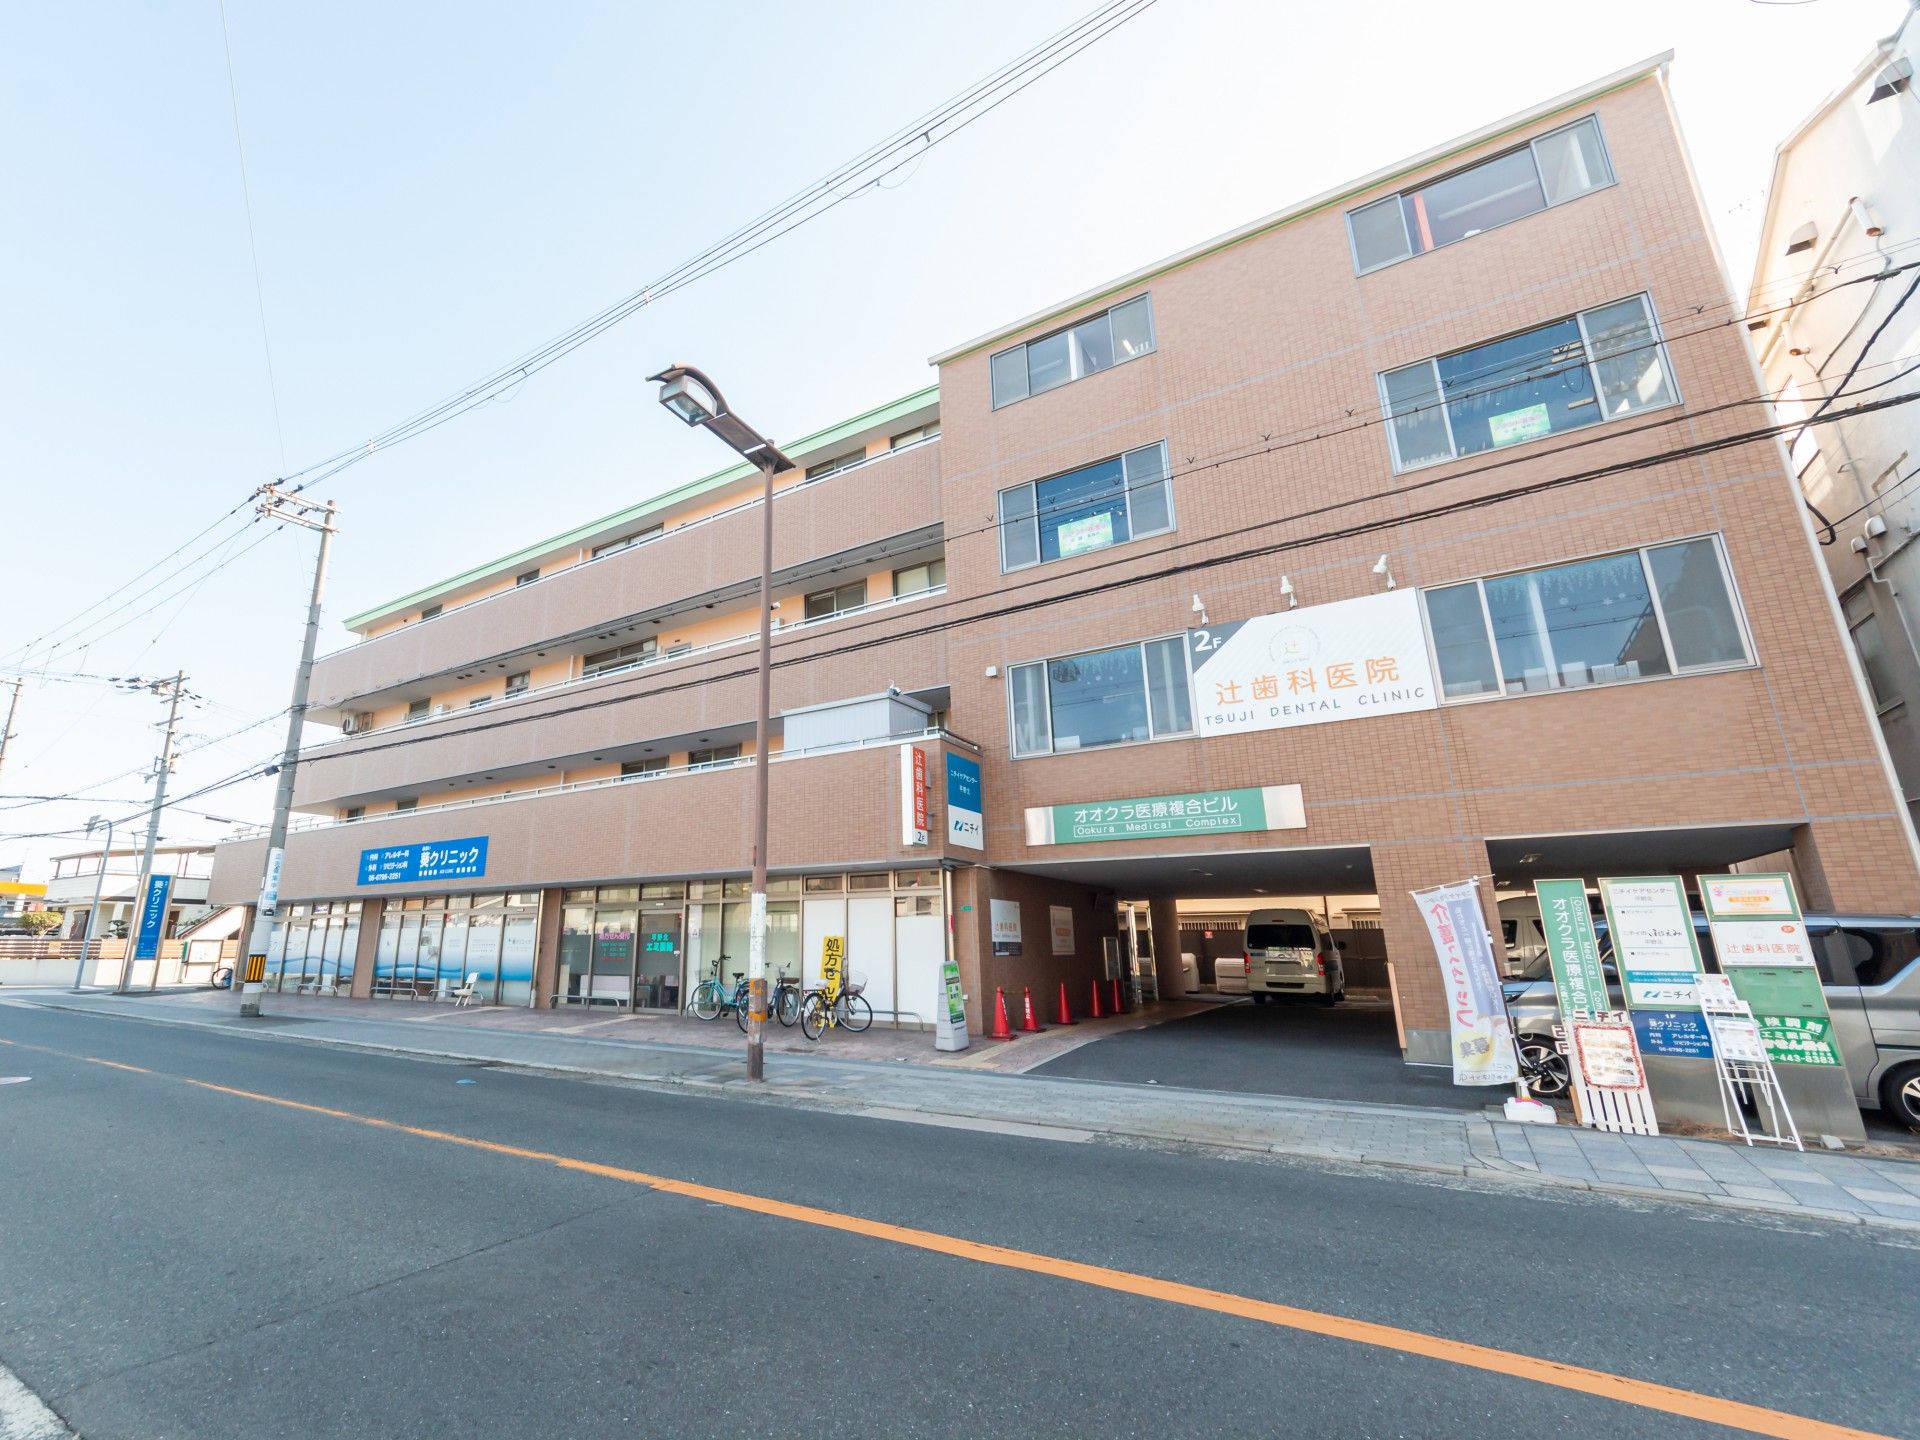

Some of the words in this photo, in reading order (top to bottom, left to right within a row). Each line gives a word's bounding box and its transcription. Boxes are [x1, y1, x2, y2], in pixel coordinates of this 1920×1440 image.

[1194, 630, 1222, 652] 2F
[1215, 655, 1400, 706] 辻歯科医院
[1204, 710, 1255, 726] TSUJI
[1270, 698, 1341, 717] DENTAL
[1358, 687, 1425, 706] CLINIC
[1073, 796, 1238, 823] オオクラ医療複合ビル
[964, 822, 979, 836] ニチイ
[1077, 824, 1115, 835] Ookura
[1126, 820, 1172, 833] Medical
[1185, 816, 1237, 828] Complex
[917, 831, 925, 843] 2F
[1726, 943, 1801, 954] 辻歯科医院
[1582, 942, 1598, 979] Medical
[1663, 990, 1692, 999] ニチイ
[1575, 1010, 1625, 1023] ニチイ
[1554, 1026, 1570, 1054] 2F
